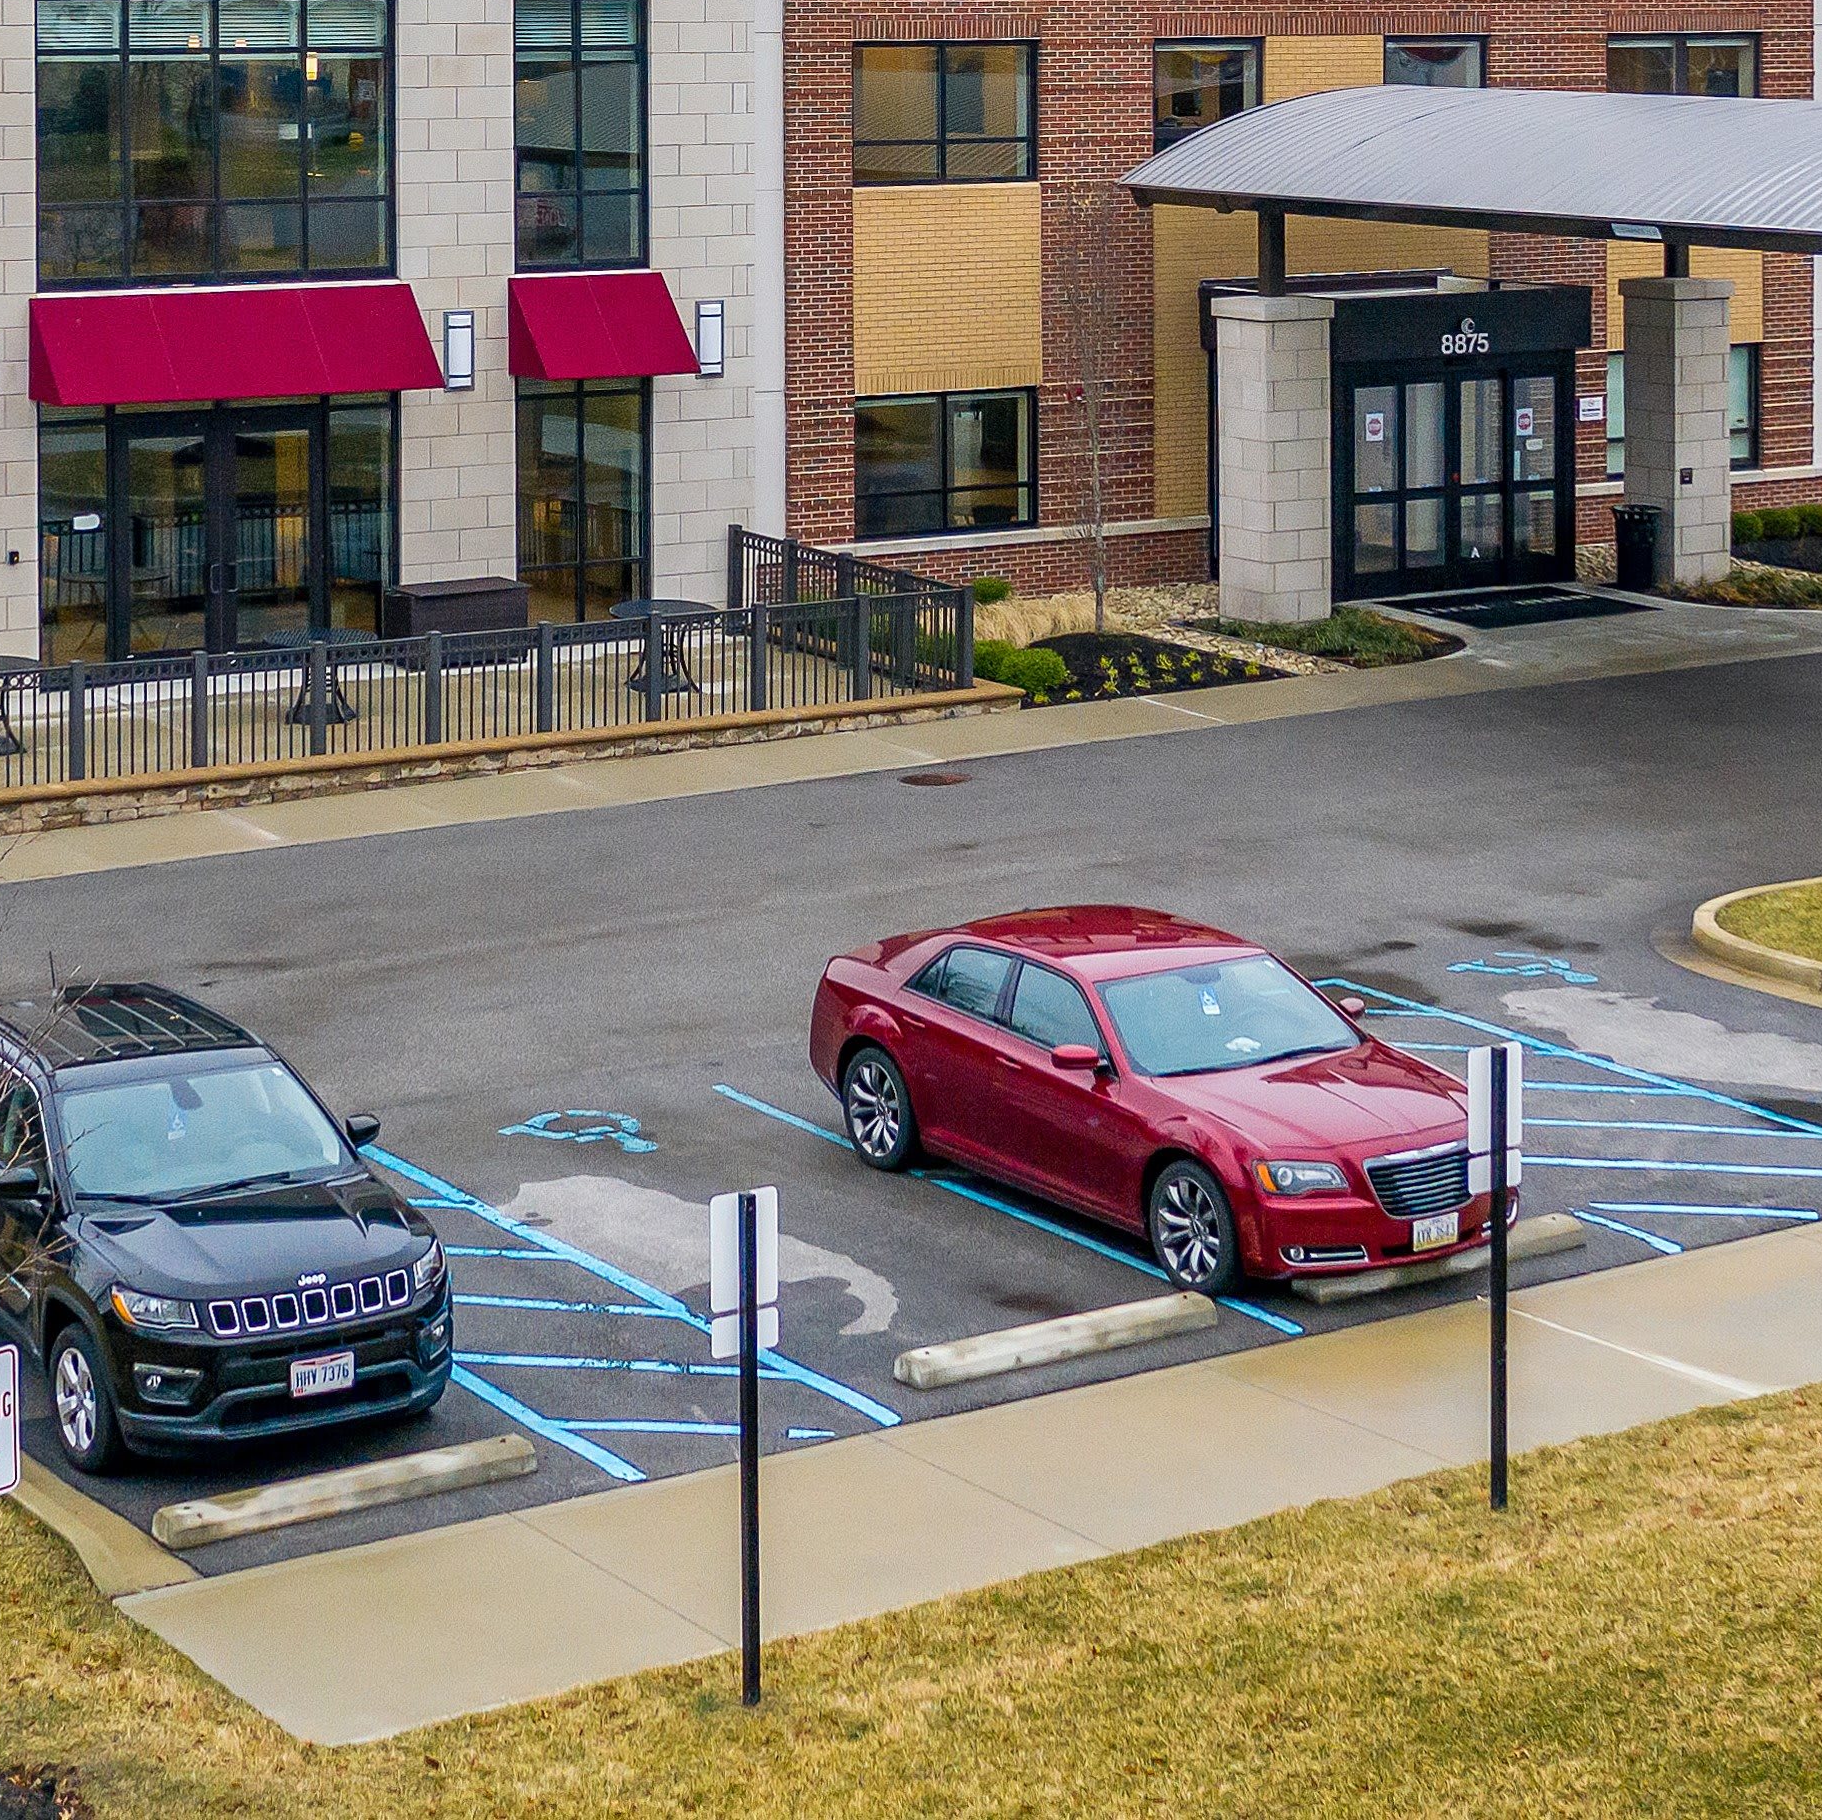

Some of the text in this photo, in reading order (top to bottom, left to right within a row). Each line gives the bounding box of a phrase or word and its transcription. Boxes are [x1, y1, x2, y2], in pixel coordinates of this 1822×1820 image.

[1441, 333, 1489, 354] 8875
[298, 1273, 327, 1286] Jeep
[321, 1363, 349, 1383] 7376
